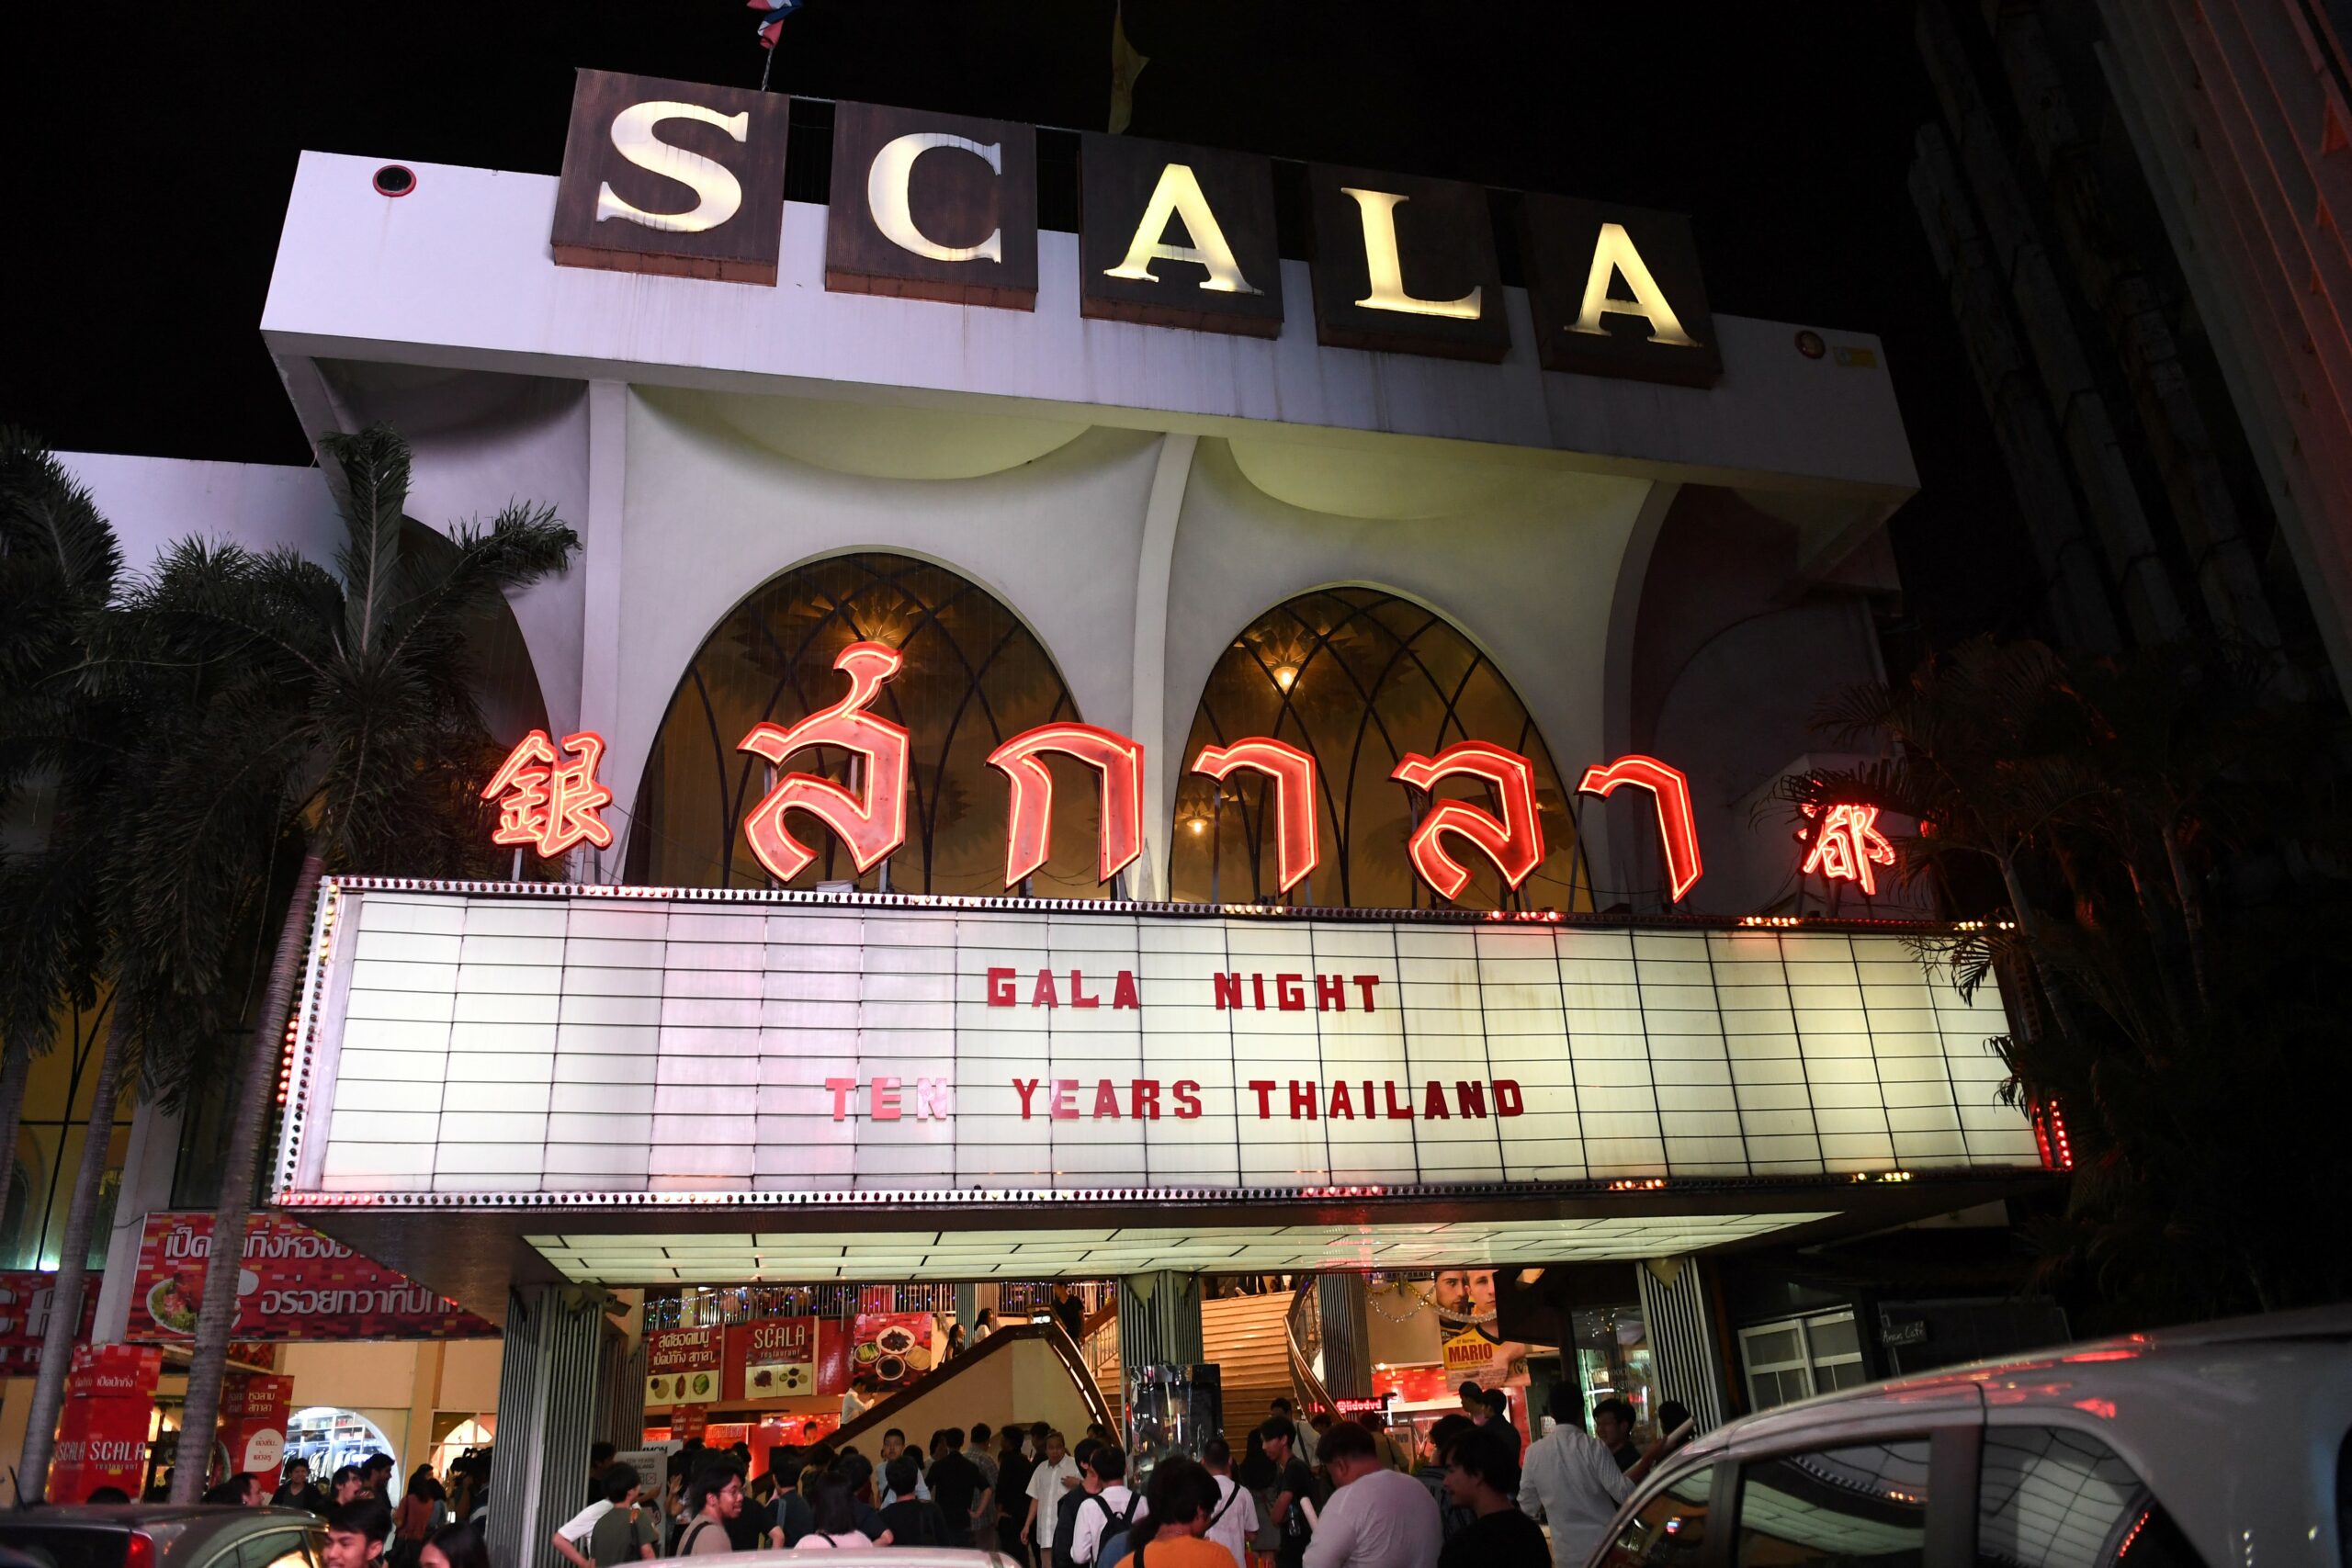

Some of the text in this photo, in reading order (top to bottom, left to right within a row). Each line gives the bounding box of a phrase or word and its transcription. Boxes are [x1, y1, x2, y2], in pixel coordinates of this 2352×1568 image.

[596, 100, 1706, 347] SCALA
[737, 641, 1705, 904] สกาลา
[481, 729, 614, 859] 銀
[988, 967, 1380, 1012] GALA NIGHT
[826, 1077, 1524, 1122] TEN YEARS THAILAND
[753, 1325, 806, 1349] SCALA
[761, 1349, 800, 1359] restaurant
[1448, 1343, 1493, 1362] MARIO
[1336, 1399, 1383, 1414] @lidodvd
[57, 1441, 85, 1461] SCALA
[90, 1441, 146, 1461] SCALA
